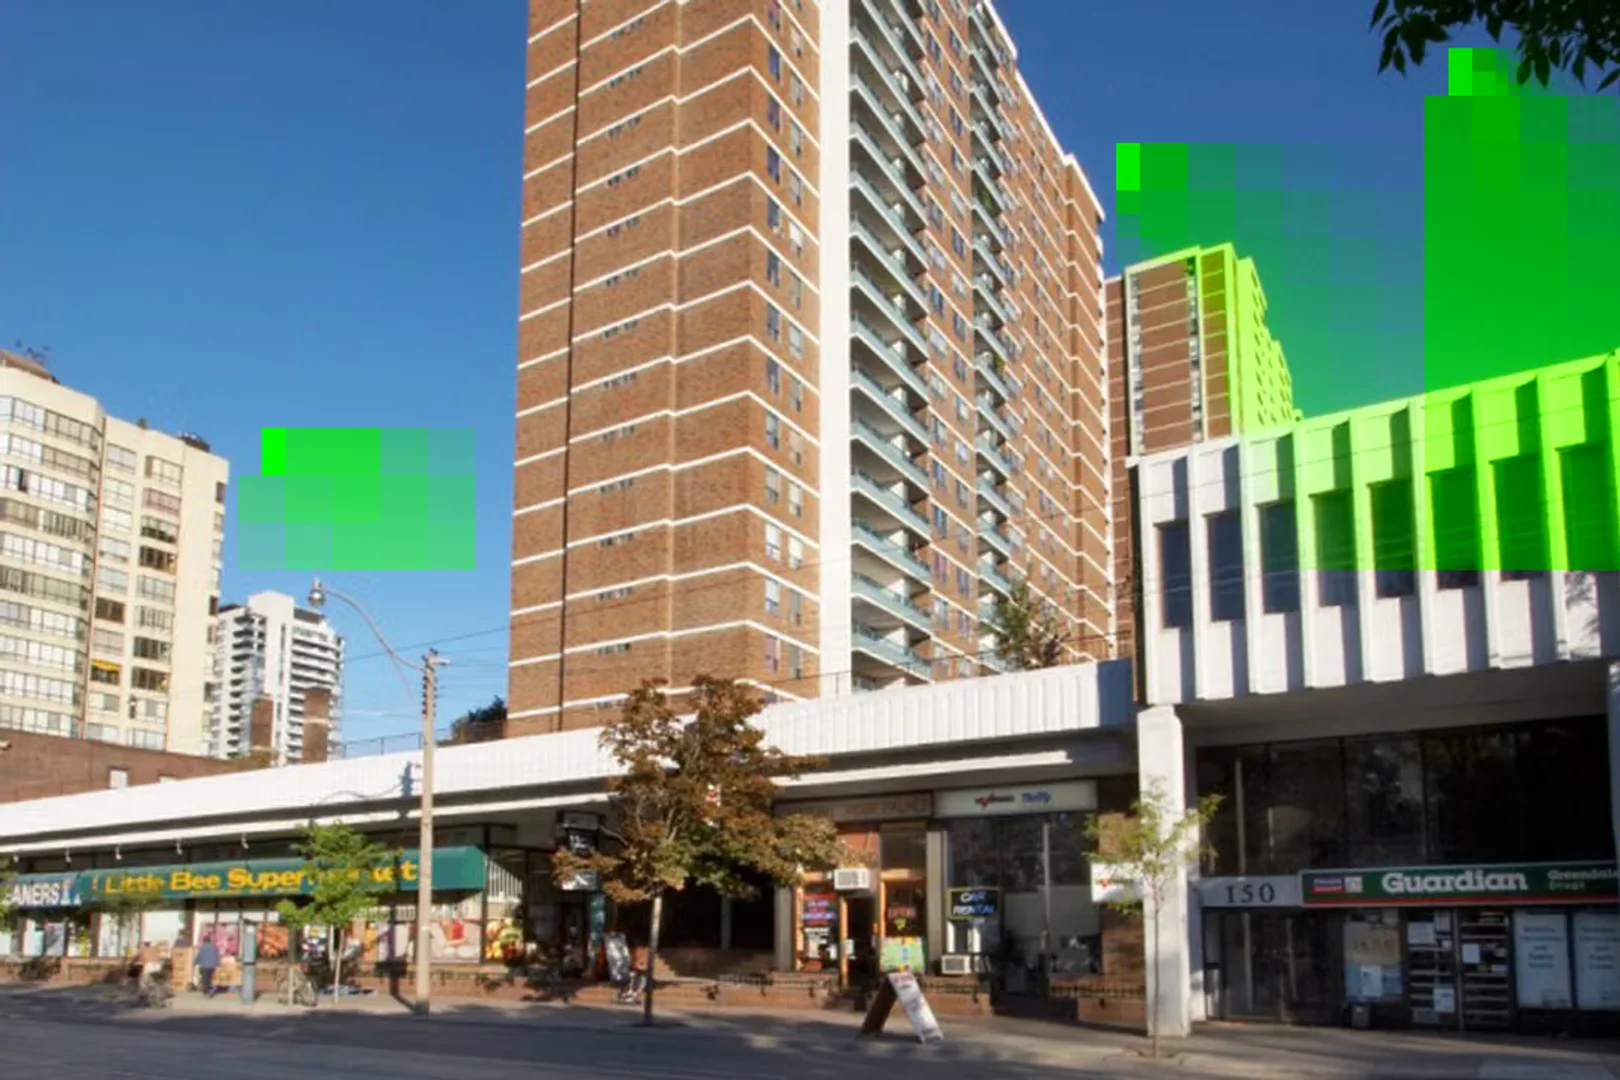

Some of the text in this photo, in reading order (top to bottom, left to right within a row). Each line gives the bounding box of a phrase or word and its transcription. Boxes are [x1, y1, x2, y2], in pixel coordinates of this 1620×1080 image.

[170, 869, 221, 890] Bee
[227, 859, 417, 889] Superet
[1381, 870, 1529, 892] Guardian
[960, 890, 986, 903] CAR
[1226, 882, 1276, 904] 150
[952, 903, 995, 915] RENTAL
